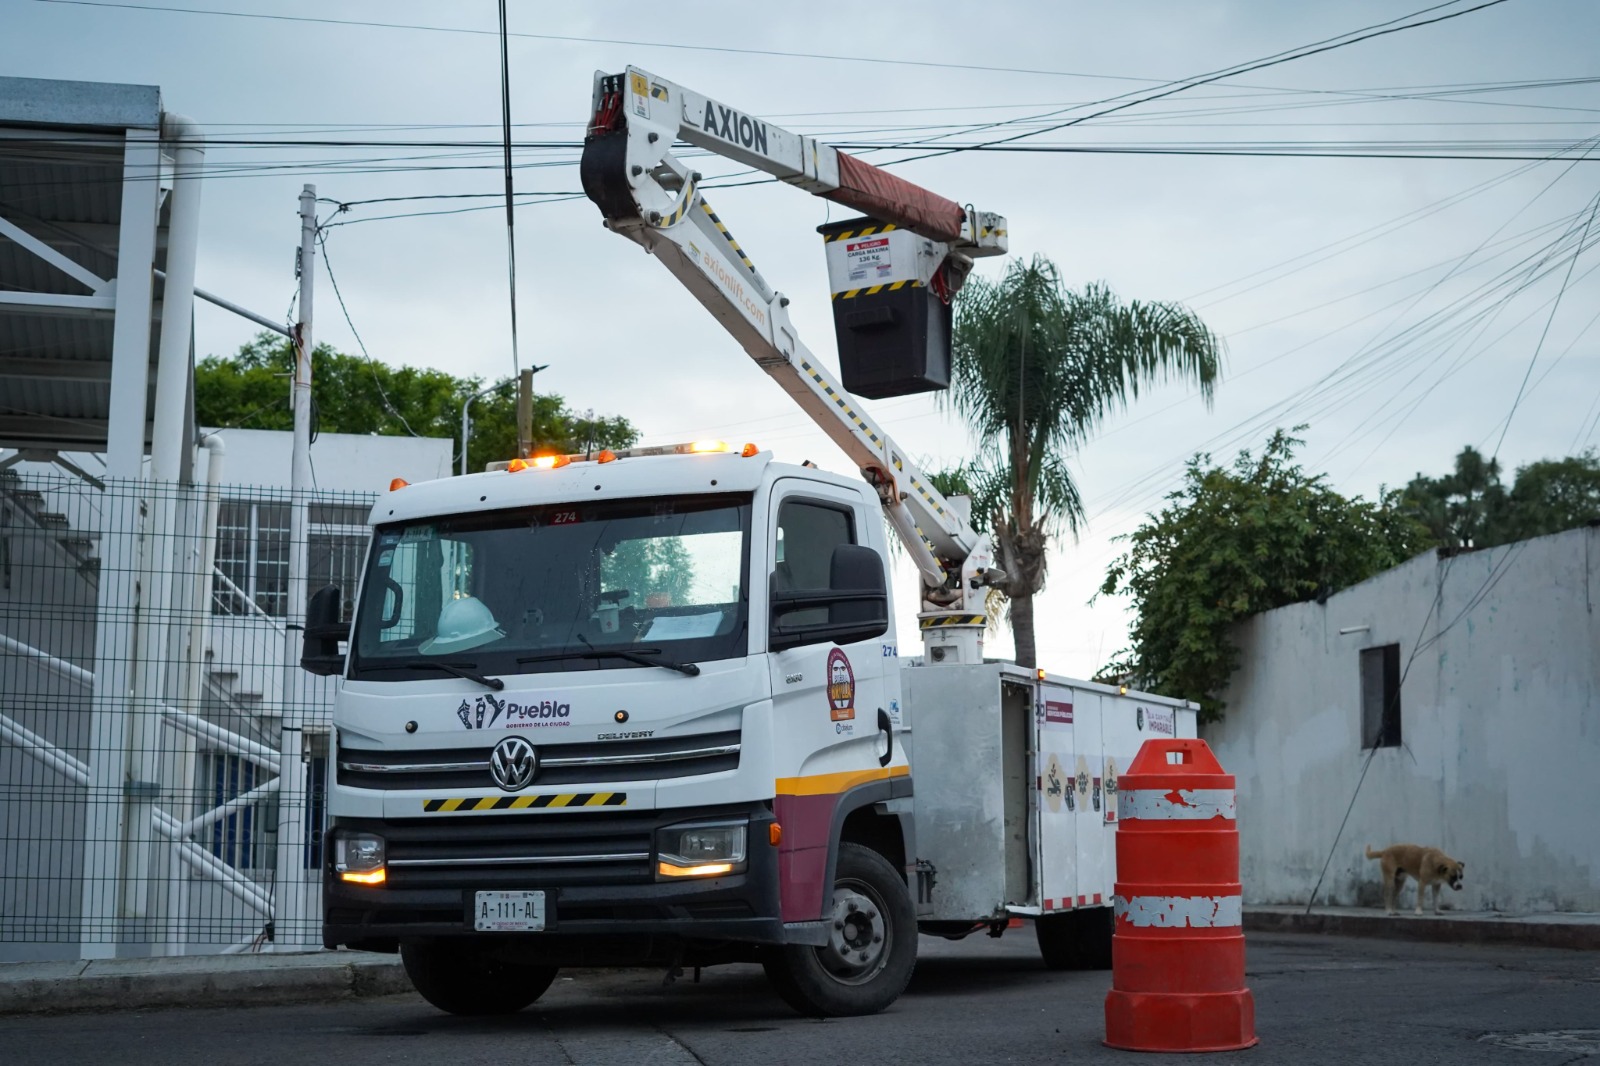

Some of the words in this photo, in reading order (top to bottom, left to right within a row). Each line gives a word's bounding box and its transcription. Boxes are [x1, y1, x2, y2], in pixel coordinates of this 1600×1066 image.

[703, 100, 768, 156] AXION
[704, 251, 766, 326] axionlift.com
[554, 511, 577, 523] 274
[882, 644, 898, 658] 274
[506, 700, 570, 720] Puebla
[597, 730, 655, 741] DELIVERY
[1149, 721, 1172, 734] IMPARABLE
[481, 901, 539, 919] A-111-AL
